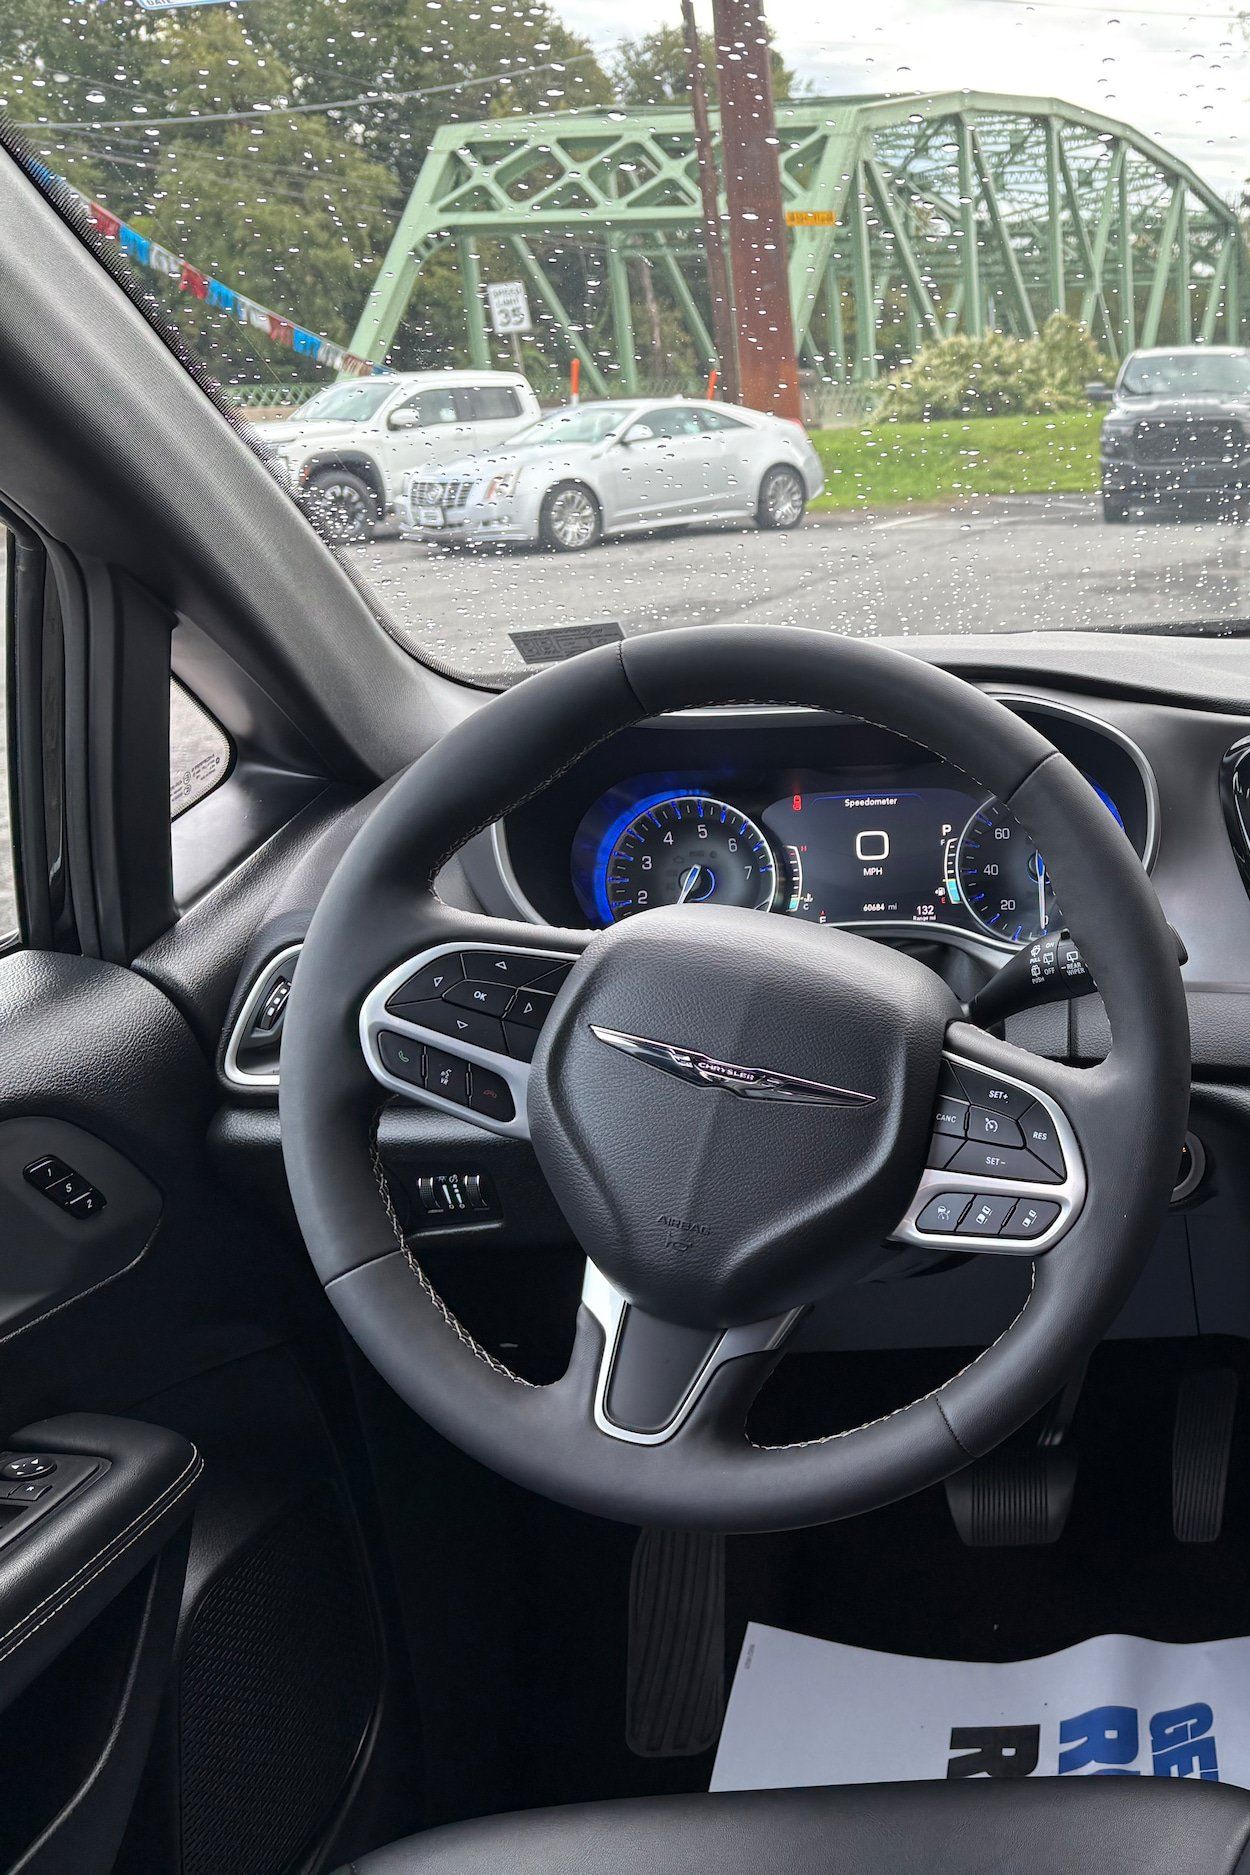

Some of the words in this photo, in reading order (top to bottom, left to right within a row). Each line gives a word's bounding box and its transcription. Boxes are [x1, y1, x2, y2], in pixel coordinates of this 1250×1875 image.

[498, 306, 524, 327] 35
[845, 797, 898, 808] Speedometer
[697, 824, 708, 839] 5
[942, 824, 952, 837] P
[994, 828, 1010, 839] 60
[663, 831, 674, 845] 4
[728, 838, 738, 852] 6
[642, 855, 652, 870] 3
[744, 865, 752, 880] 7
[863, 867, 882, 876] MPH
[983, 864, 998, 875] 40
[637, 890, 648, 904] 2
[863, 904, 885, 912] 60684
[916, 905, 934, 915] 132
[1000, 899, 1015, 910] 20
[1044, 967, 1055, 975] OFF
[1066, 962, 1081, 970] REAR
[1067, 968, 1085, 976] WIPER
[473, 990, 487, 1001] OK
[698, 1062, 754, 1080] CHRYSLER
[936, 1113, 957, 1123] CANC
[1033, 1132, 1047, 1141] RES
[65, 1183, 72, 1193] S
[87, 1199, 92, 1209] 2
[657, 1215, 711, 1236] AIRBAG
[1149, 1702, 1218, 1782] GE
